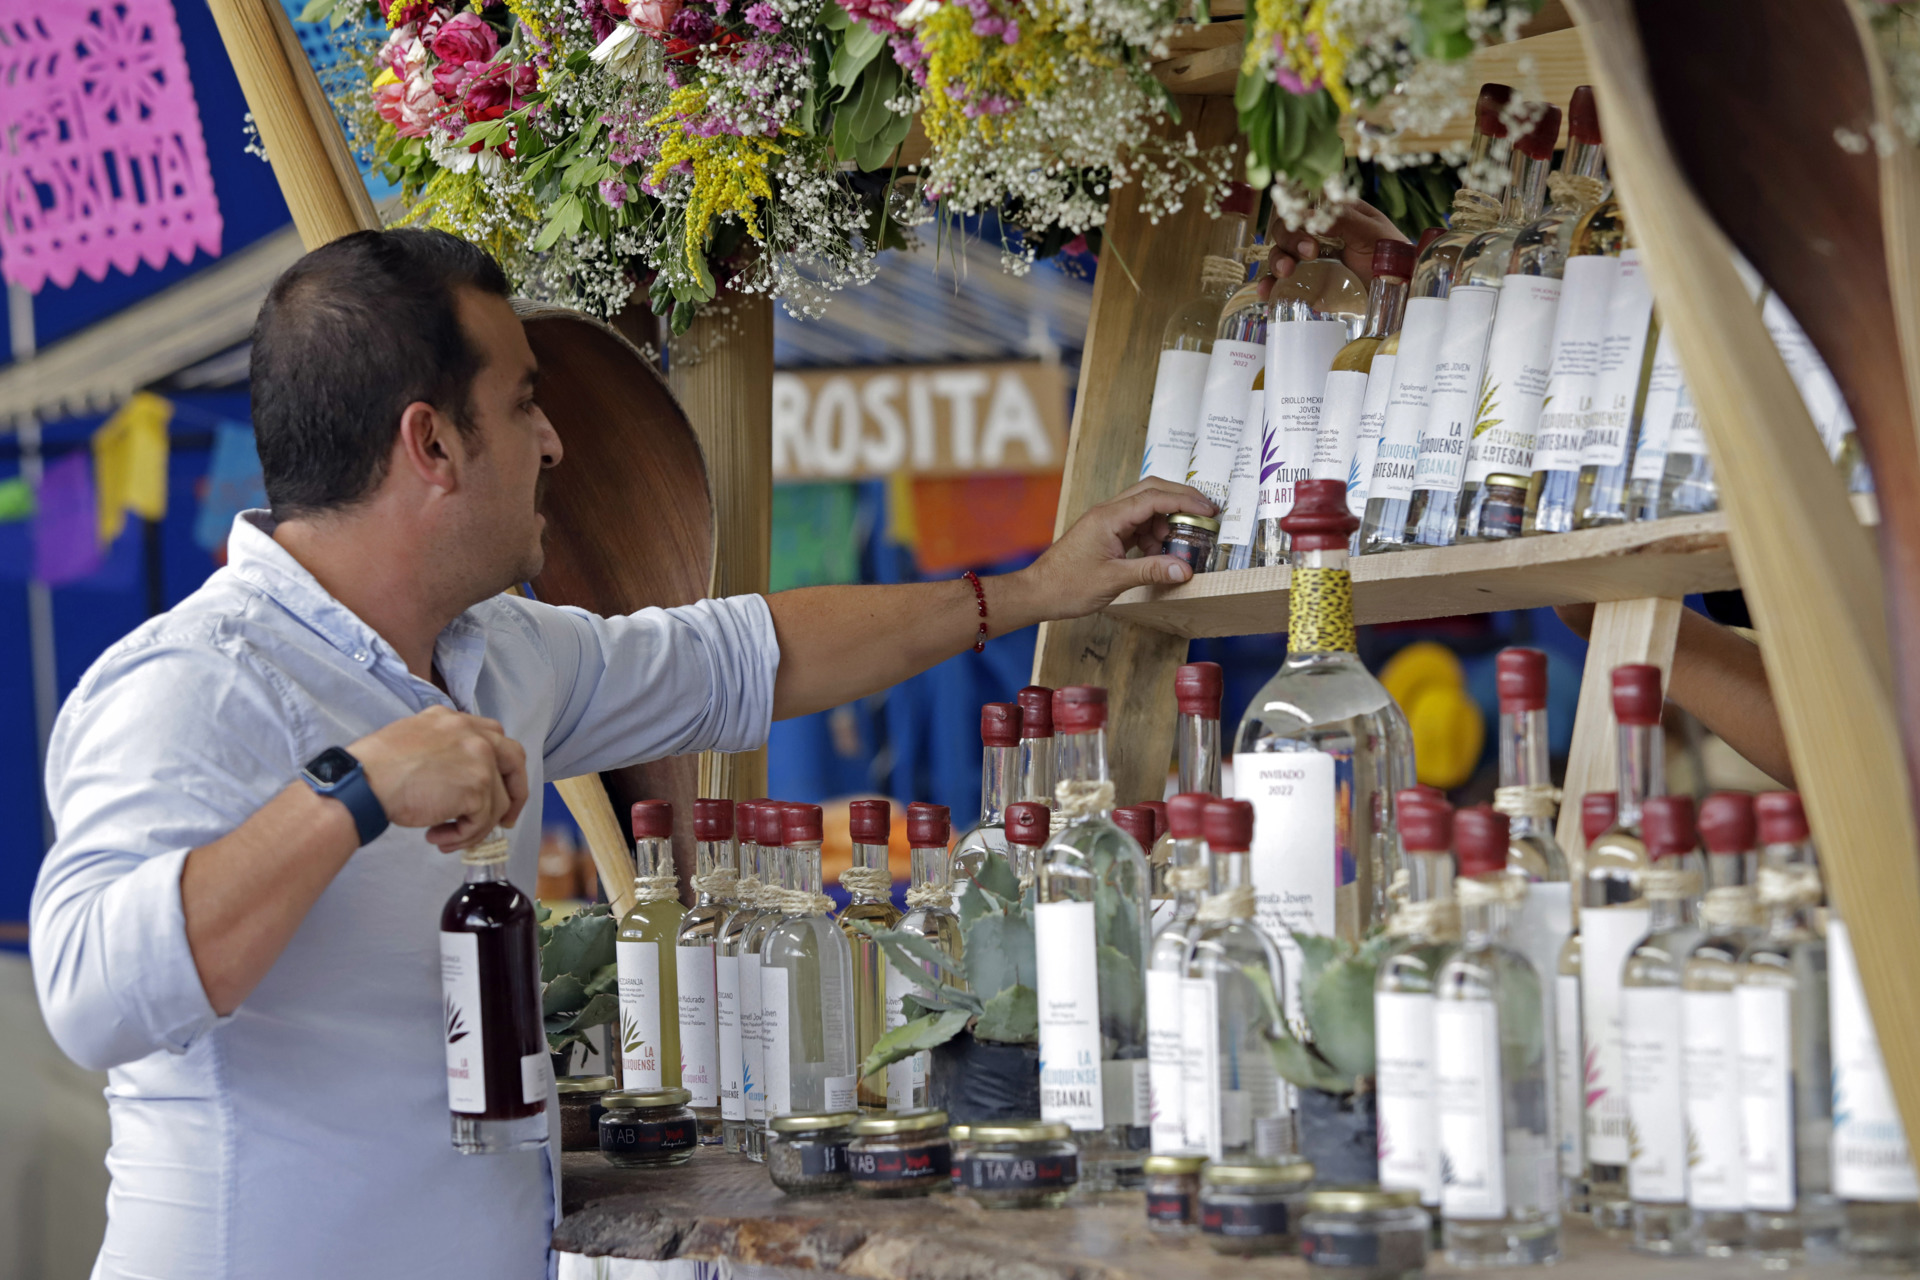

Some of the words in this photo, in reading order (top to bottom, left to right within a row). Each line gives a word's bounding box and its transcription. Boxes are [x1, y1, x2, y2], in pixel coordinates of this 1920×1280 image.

[1229, 351, 1257, 361] INVITADO
[1451, 362, 1471, 372] JOVEN
[1400, 383, 1428, 392] Papalometl
[1281, 397, 1305, 405] CRIOLLO
[1299, 406, 1320, 414] JOVEN
[771, 369, 1054, 474] ROSITA
[1449, 421, 1462, 437] LA
[1259, 769, 1305, 780] INVITADO
[1268, 785, 1294, 796] 2022
[644, 1046, 654, 1058] LA
[1078, 1051, 1092, 1066] LA
[698, 1066, 706, 1074] LA
[731, 1081, 738, 1090] LA
[617, 1128, 636, 1144] AB
[1010, 1160, 1036, 1180] AB
